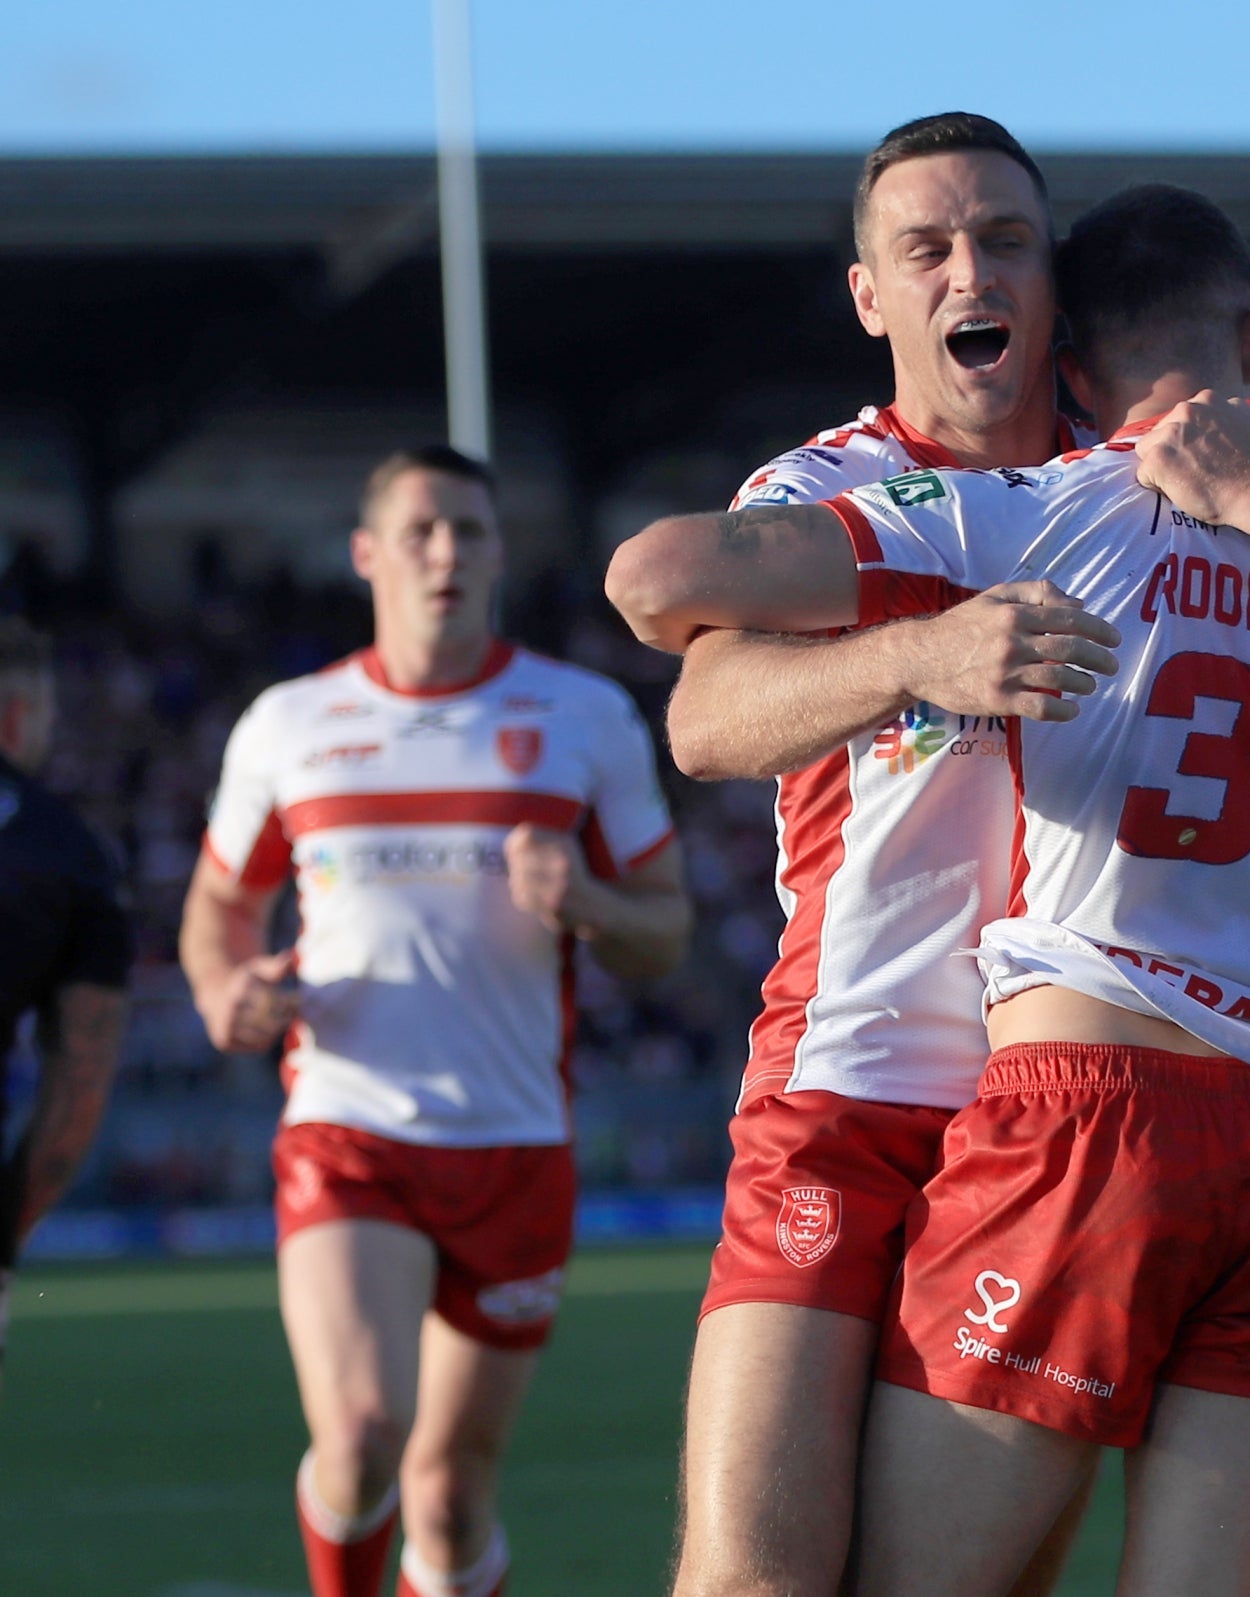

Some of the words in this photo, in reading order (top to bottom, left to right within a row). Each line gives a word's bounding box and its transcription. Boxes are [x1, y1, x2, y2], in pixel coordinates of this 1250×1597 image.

[950, 739, 978, 756] car
[790, 1189, 828, 1201] HULL
[779, 1222, 803, 1262] KINGSTON
[806, 1233, 835, 1261] ROVERS
[953, 1326, 1002, 1364] Spire
[1004, 1352, 1042, 1375] Hull
[1044, 1362, 1116, 1399] Hospital
